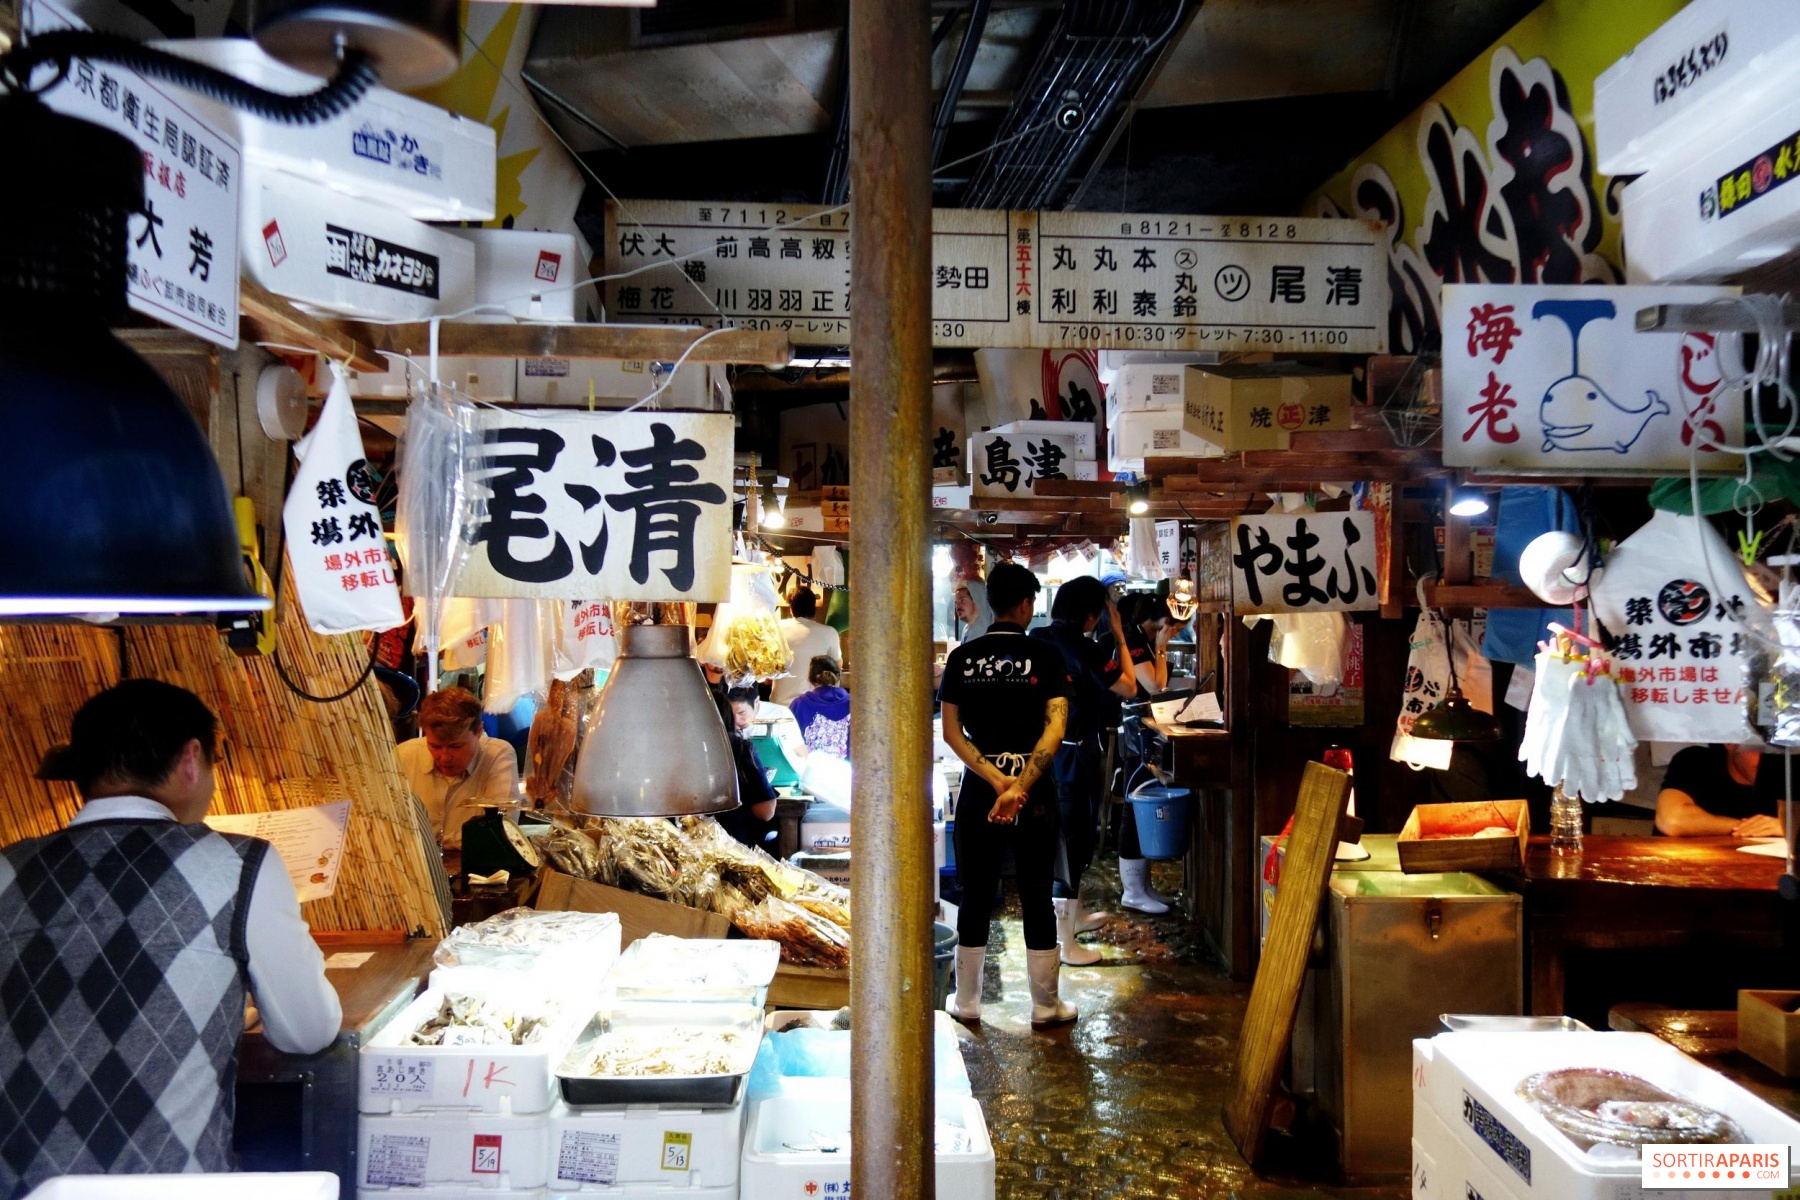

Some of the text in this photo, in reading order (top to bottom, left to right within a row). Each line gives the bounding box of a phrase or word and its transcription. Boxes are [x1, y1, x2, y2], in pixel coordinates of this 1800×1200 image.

[67, 60, 231, 191] 京都衛生局認証済
[1016, 228, 1032, 315] 第五十六棟
[1270, 265, 1362, 306] 尾清
[1462, 303, 1522, 443] 海老
[460, 422, 727, 593] 尾清
[980, 435, 1068, 493] 島津
[1233, 516, 1376, 607] やまふ
[964, 654, 1032, 677] こだわり
